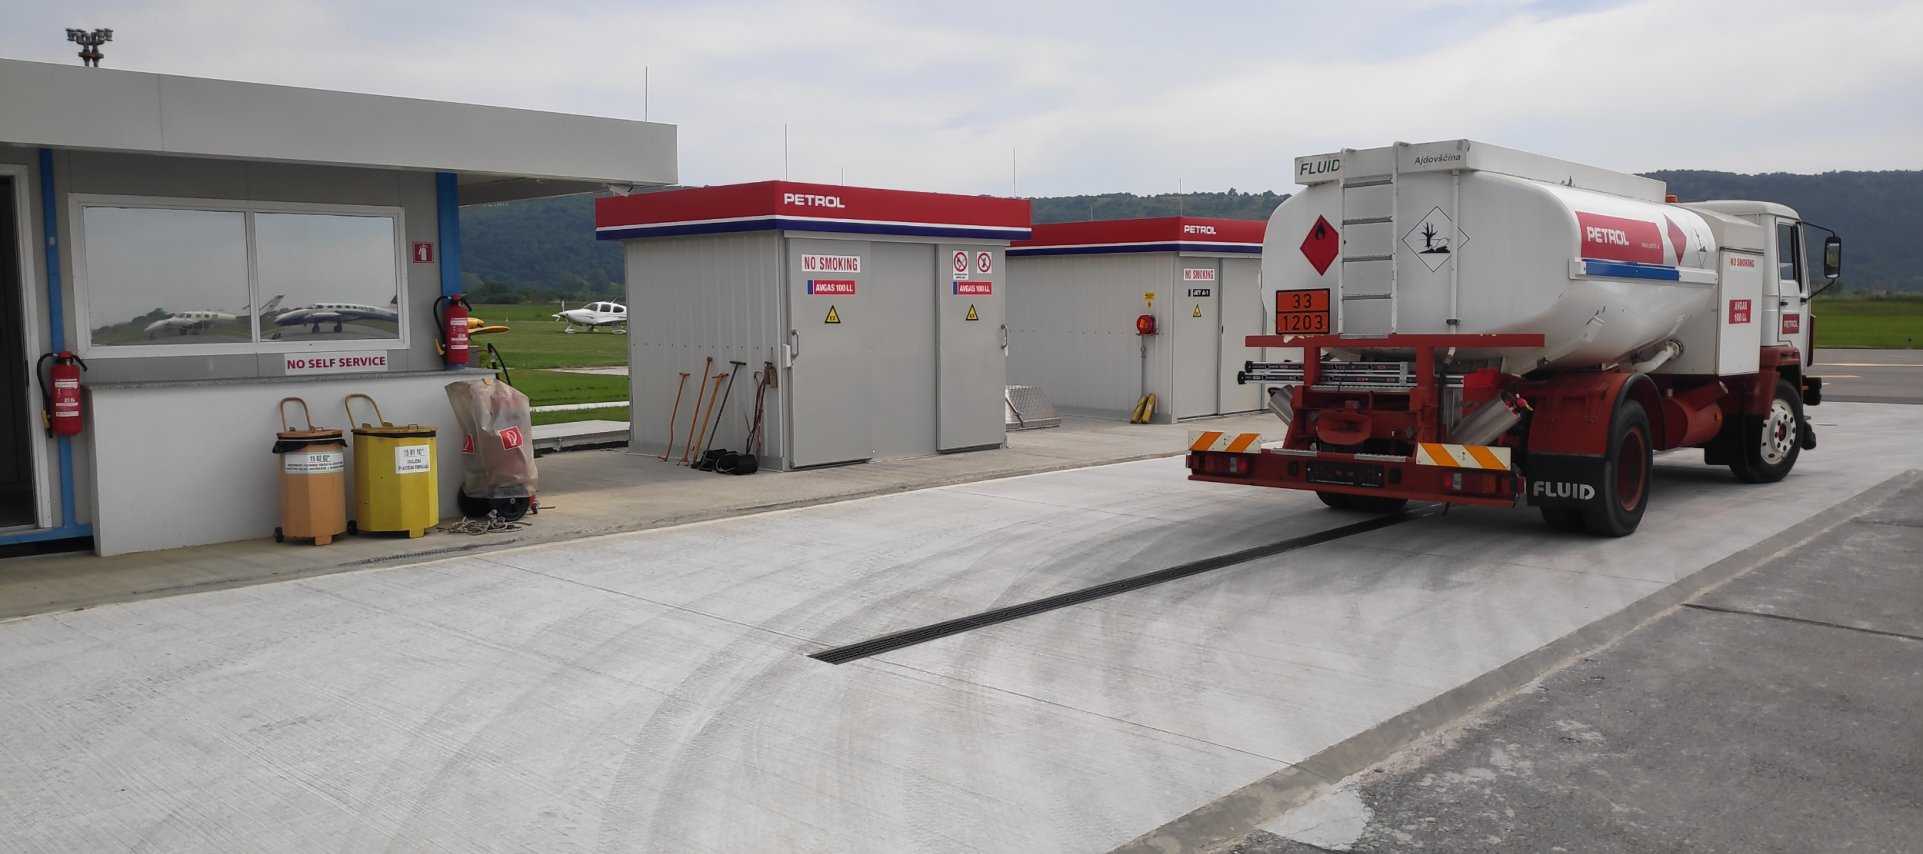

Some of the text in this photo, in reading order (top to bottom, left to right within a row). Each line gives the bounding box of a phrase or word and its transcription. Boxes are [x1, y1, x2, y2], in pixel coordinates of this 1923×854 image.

[1414, 153, 1462, 165] Ajdovščina
[1300, 159, 1341, 176] FLUID
[783, 192, 846, 209] PETROL
[1183, 224, 1217, 235] PETROL
[1586, 226, 1630, 246] PETROL
[804, 256, 858, 271] NO SMOKING
[1730, 257, 1755, 268] NO SMOKING
[1184, 269, 1214, 280] NO SMOKING
[815, 284, 854, 293] AVGAS 100 LL
[959, 285, 976, 293] AVGAS
[976, 285, 985, 293] 100
[1292, 293, 1312, 309] 33
[1734, 301, 1748, 311] AVGAS
[1282, 314, 1323, 331] 1203
[287, 356, 386, 369] NO SELF SERVICE
[1533, 481, 1596, 500] FLUID
